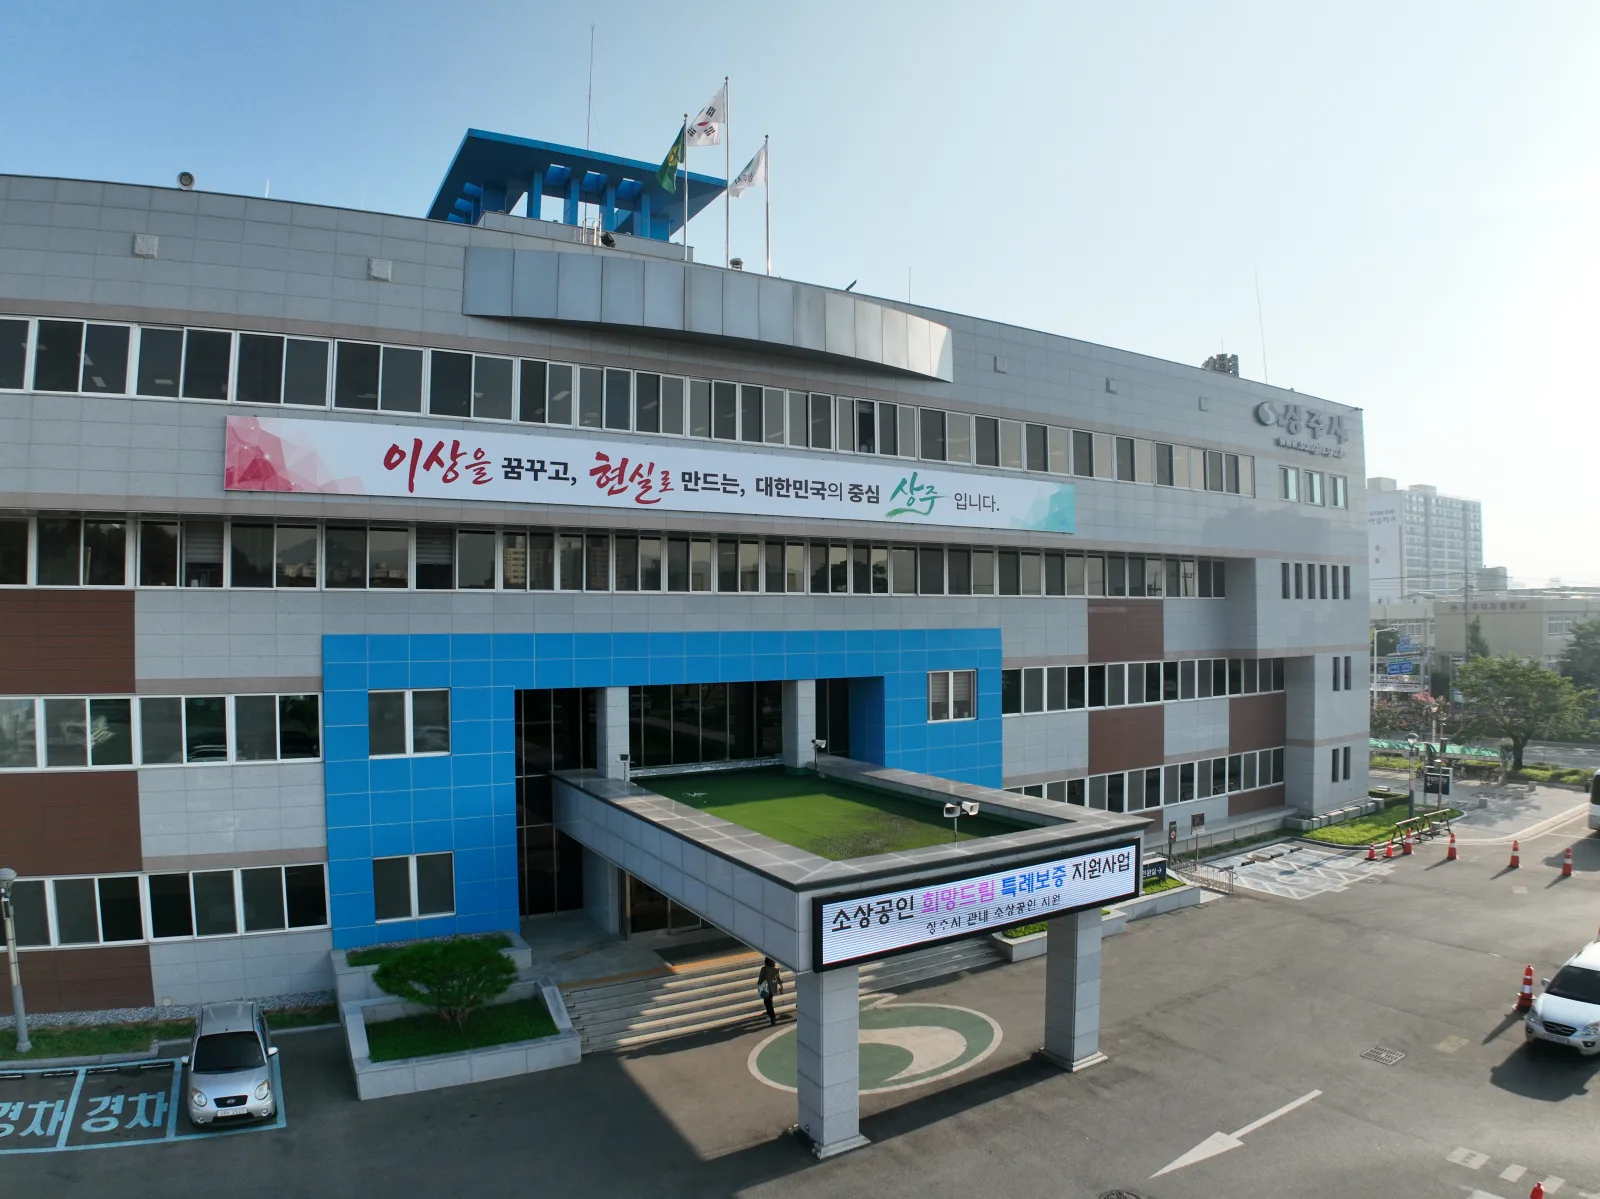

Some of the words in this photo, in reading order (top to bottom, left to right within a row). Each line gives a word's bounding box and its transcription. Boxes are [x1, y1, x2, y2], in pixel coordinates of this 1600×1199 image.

[384, 438, 493, 493] 이상을
[501, 456, 577, 485] 꿈꾸고,
[589, 451, 674, 504] 현실로
[681, 470, 745, 497] 만드는,
[755, 475, 843, 502] 대한민국의
[848, 482, 880, 505] 중심
[885, 471, 945, 519] 상주
[954, 492, 1000, 513] 입니다.
[831, 895, 914, 932] 소상공인
[921, 880, 995, 913] 희망드림
[1001, 865, 1067, 897] 특례보증
[1072, 852, 1130, 881] 지원사업
[994, 899, 1036, 918] 소상공인
[1041, 893, 1061, 907] 지원
[0, 1100, 65, 1138] 경차
[81, 1091, 169, 1133] 경차
